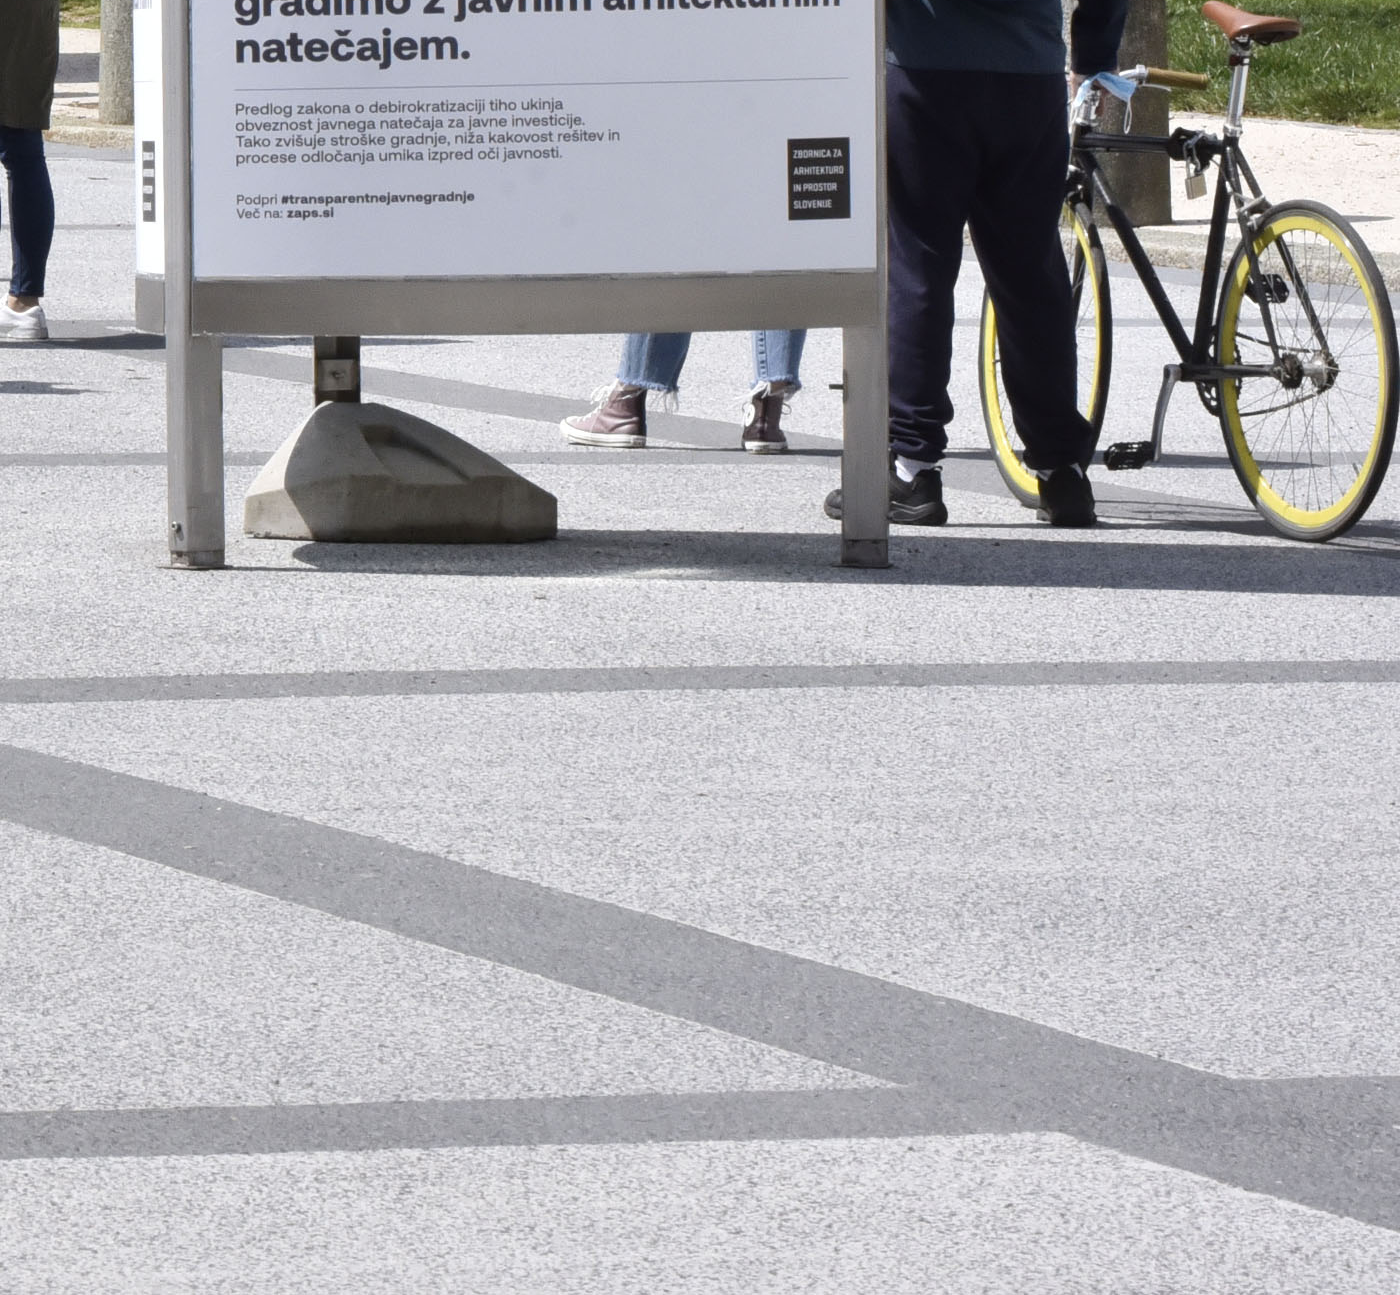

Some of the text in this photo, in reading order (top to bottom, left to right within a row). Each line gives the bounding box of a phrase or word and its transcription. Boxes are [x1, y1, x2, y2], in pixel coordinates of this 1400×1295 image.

[235, 27, 471, 70] natečajem.
[235, 98, 564, 118] Predlog zakona o debirokratizaciji tiho ukinja
[235, 114, 585, 133] obveznost javnega natečaja za javne investicije.
[236, 129, 620, 150] Tako zvišuje stroške gradnje, niža kakovost rešitev in
[236, 146, 562, 167] procese odločanja umika izpred oči javnosti.
[792, 148, 843, 159] ZBORNICA ZA
[793, 165, 844, 176] ARHITEKTURO
[793, 182, 837, 192] IN PROSTOR
[236, 191, 475, 207] Podpri #transparentnejavnegradnje
[793, 198, 832, 209] SLOVENIJE
[236, 207, 334, 221] Več na: zaps.si
